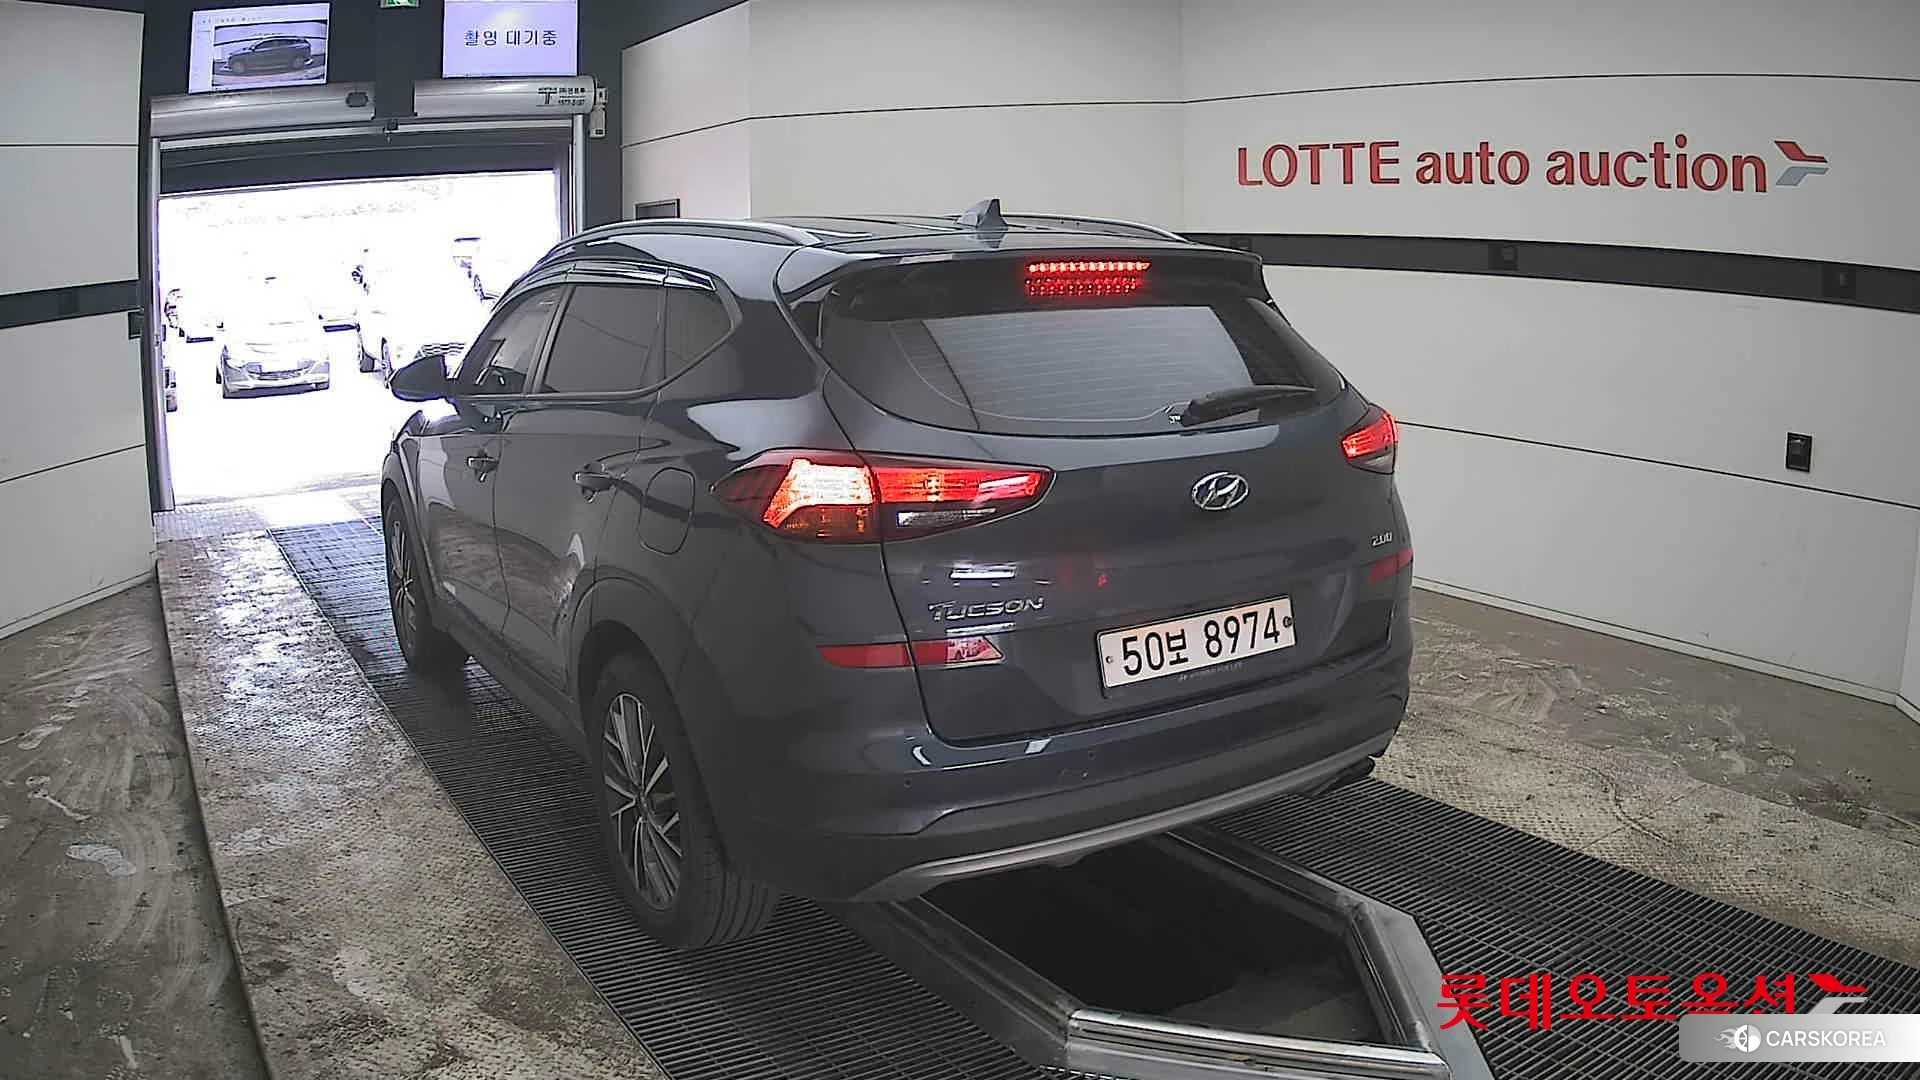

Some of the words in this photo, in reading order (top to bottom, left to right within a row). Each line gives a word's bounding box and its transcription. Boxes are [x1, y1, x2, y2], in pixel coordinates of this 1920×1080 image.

[464, 30, 497, 46] 촬영
[505, 30, 559, 46] 대기중
[1238, 141, 1400, 187] LOTTE
[1415, 141, 1530, 185] auto
[1546, 134, 1767, 192] auction
[928, 597, 1044, 621] TUCSON
[1121, 629, 1189, 675] 50보
[1204, 608, 1280, 657] 8974
